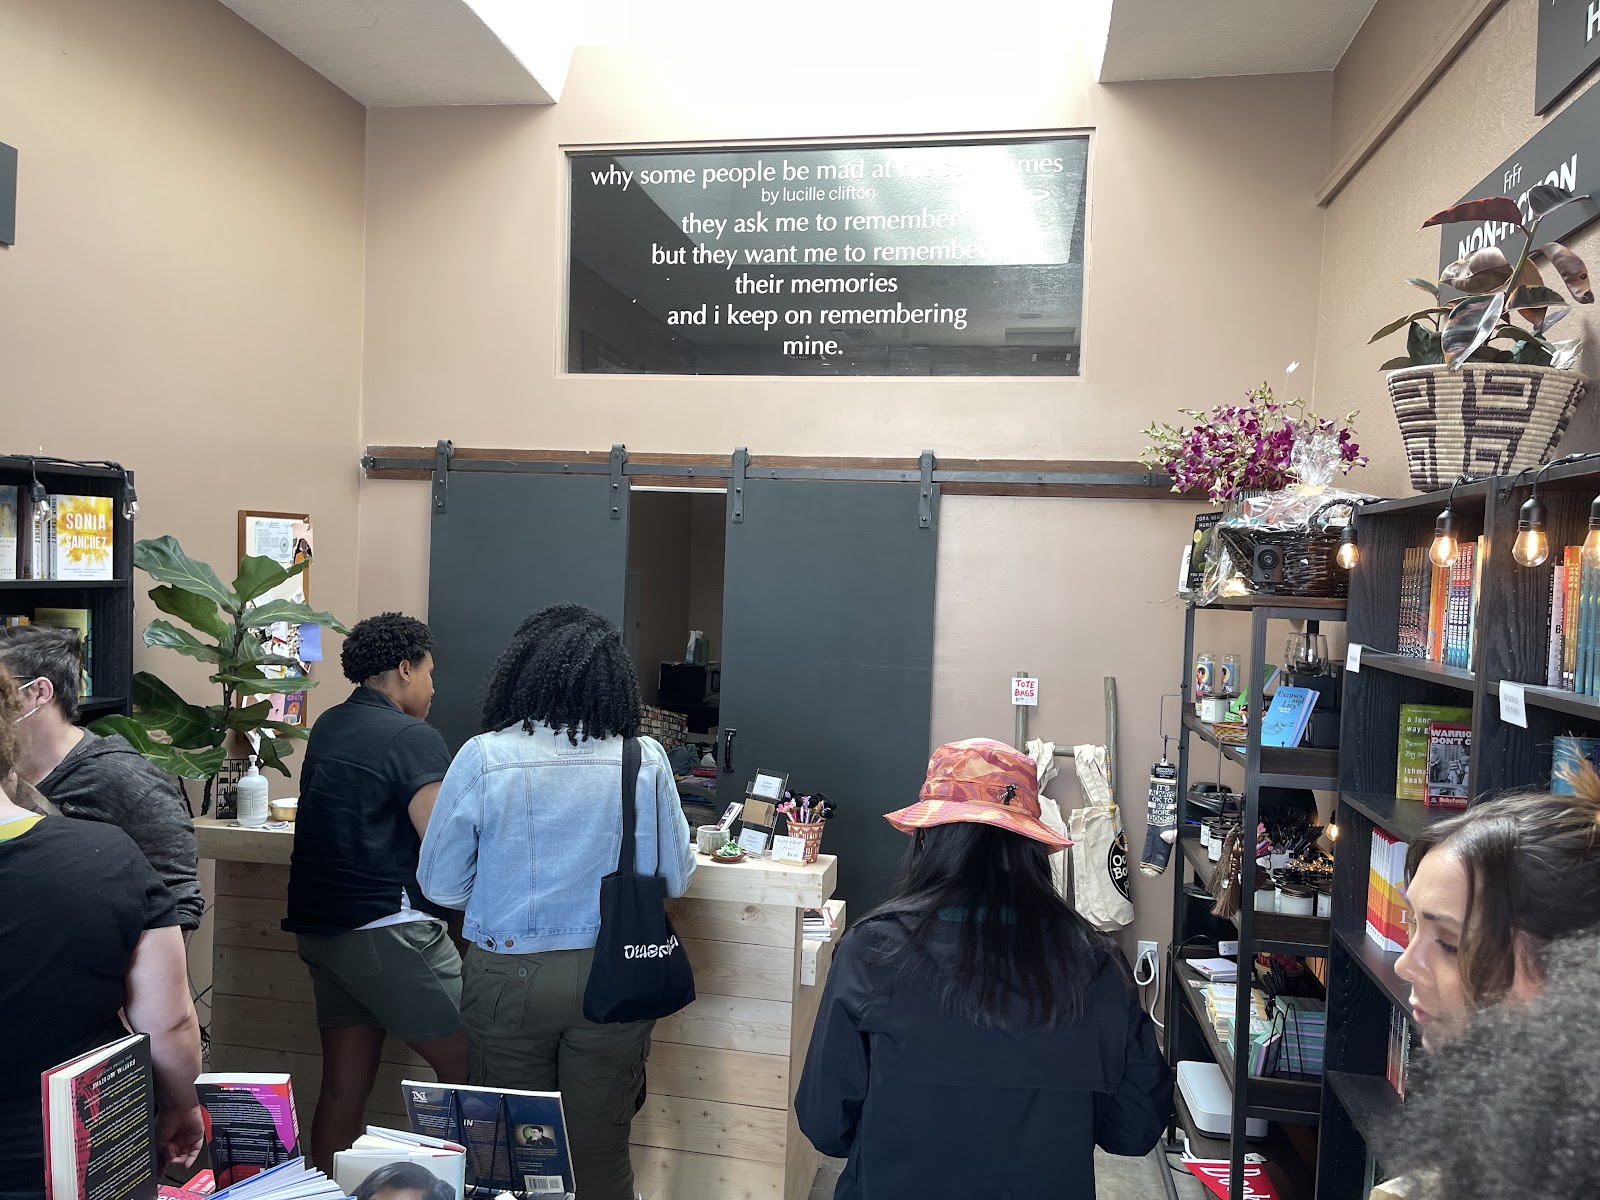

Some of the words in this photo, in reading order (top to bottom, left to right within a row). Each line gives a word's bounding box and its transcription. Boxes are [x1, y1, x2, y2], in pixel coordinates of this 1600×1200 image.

[591, 164, 634, 191] why
[640, 168, 696, 184] some
[702, 160, 776, 189] people
[783, 160, 810, 180] be
[817, 158, 864, 179] mad
[872, 161, 894, 178] at
[761, 188, 779, 205] by
[783, 186, 825, 201] lucille
[828, 185, 876, 201] clifton
[682, 213, 728, 239] they
[734, 211, 769, 233] ask
[776, 216, 809, 232] me
[815, 213, 837, 232] to
[844, 208, 957, 231] remember
[651, 243, 686, 264] but
[691, 243, 738, 270] they
[744, 247, 798, 264] want
[804, 246, 837, 262] me
[844, 245, 866, 262] to
[734, 272, 784, 294] their
[790, 271, 898, 293] memories
[667, 304, 707, 325] and
[713, 304, 720, 325] i
[727, 303, 778, 331] keep
[784, 309, 813, 325] on
[819, 301, 968, 330] remembering
[783, 335, 844, 355] mine.
[65, 513, 107, 531] SONIA
[65, 535, 107, 550] SANCHEZ
[1014, 688, 1035, 697] BAGS
[1015, 679, 1036, 689] TOTE
[1406, 726, 1421, 734] way
[1404, 776, 1423, 784] beah
[1149, 790, 1176, 798] ALWAYS
[463, 1119, 474, 1127] IN
